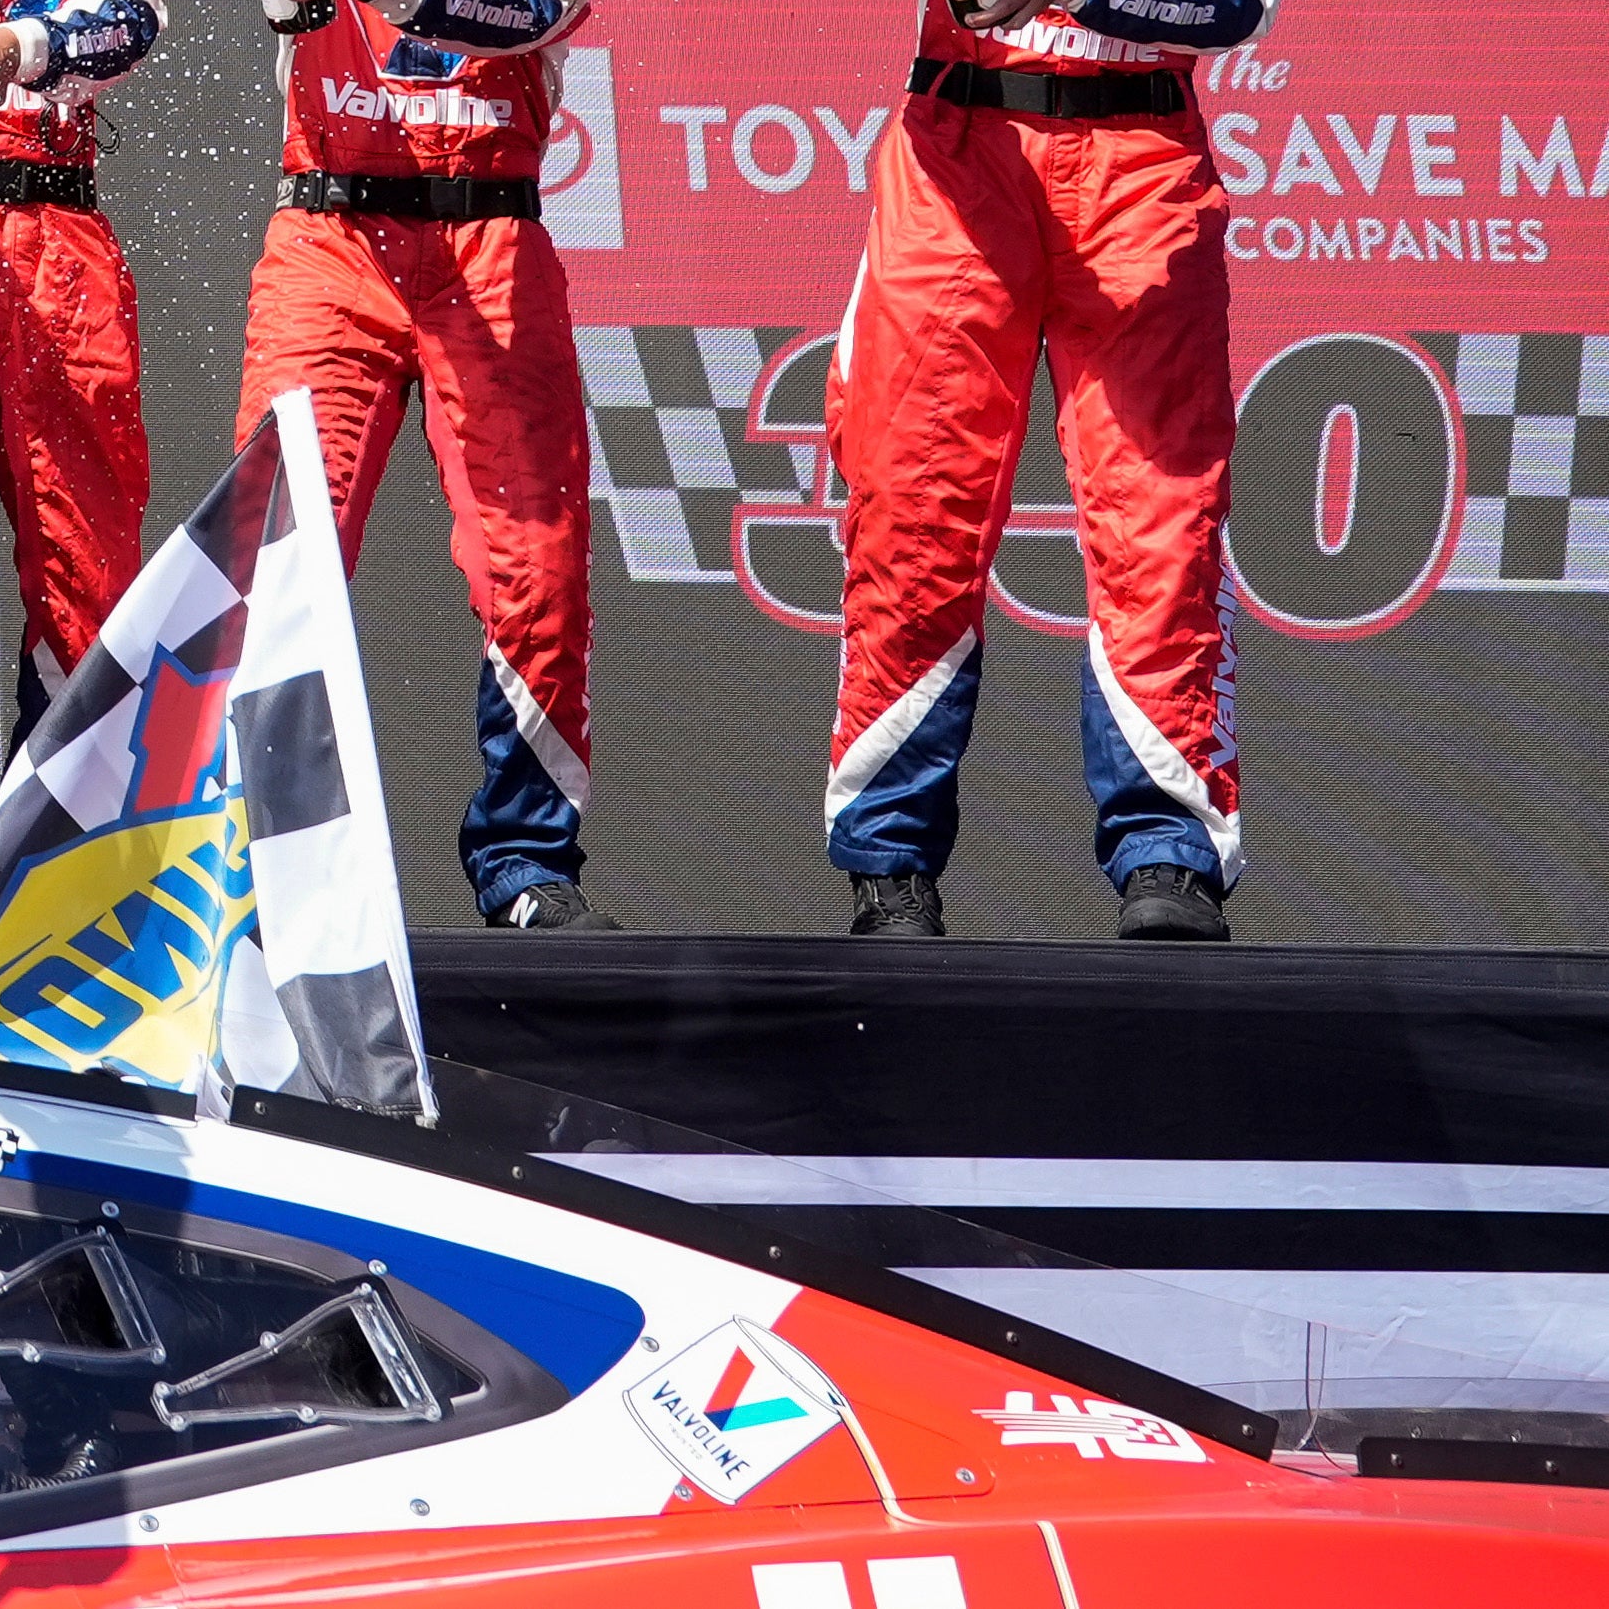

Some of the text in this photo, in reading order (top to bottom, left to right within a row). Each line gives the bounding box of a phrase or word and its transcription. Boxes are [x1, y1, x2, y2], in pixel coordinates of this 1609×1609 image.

[322, 77, 515, 129] Valvoline
[1206, 43, 1293, 94] The
[660, 104, 881, 192] TOY
[1212, 111, 1465, 197] SAVE
[1224, 216, 1550, 263] COMPANIES
[652, 1380, 751, 1481] VALVOLINE
